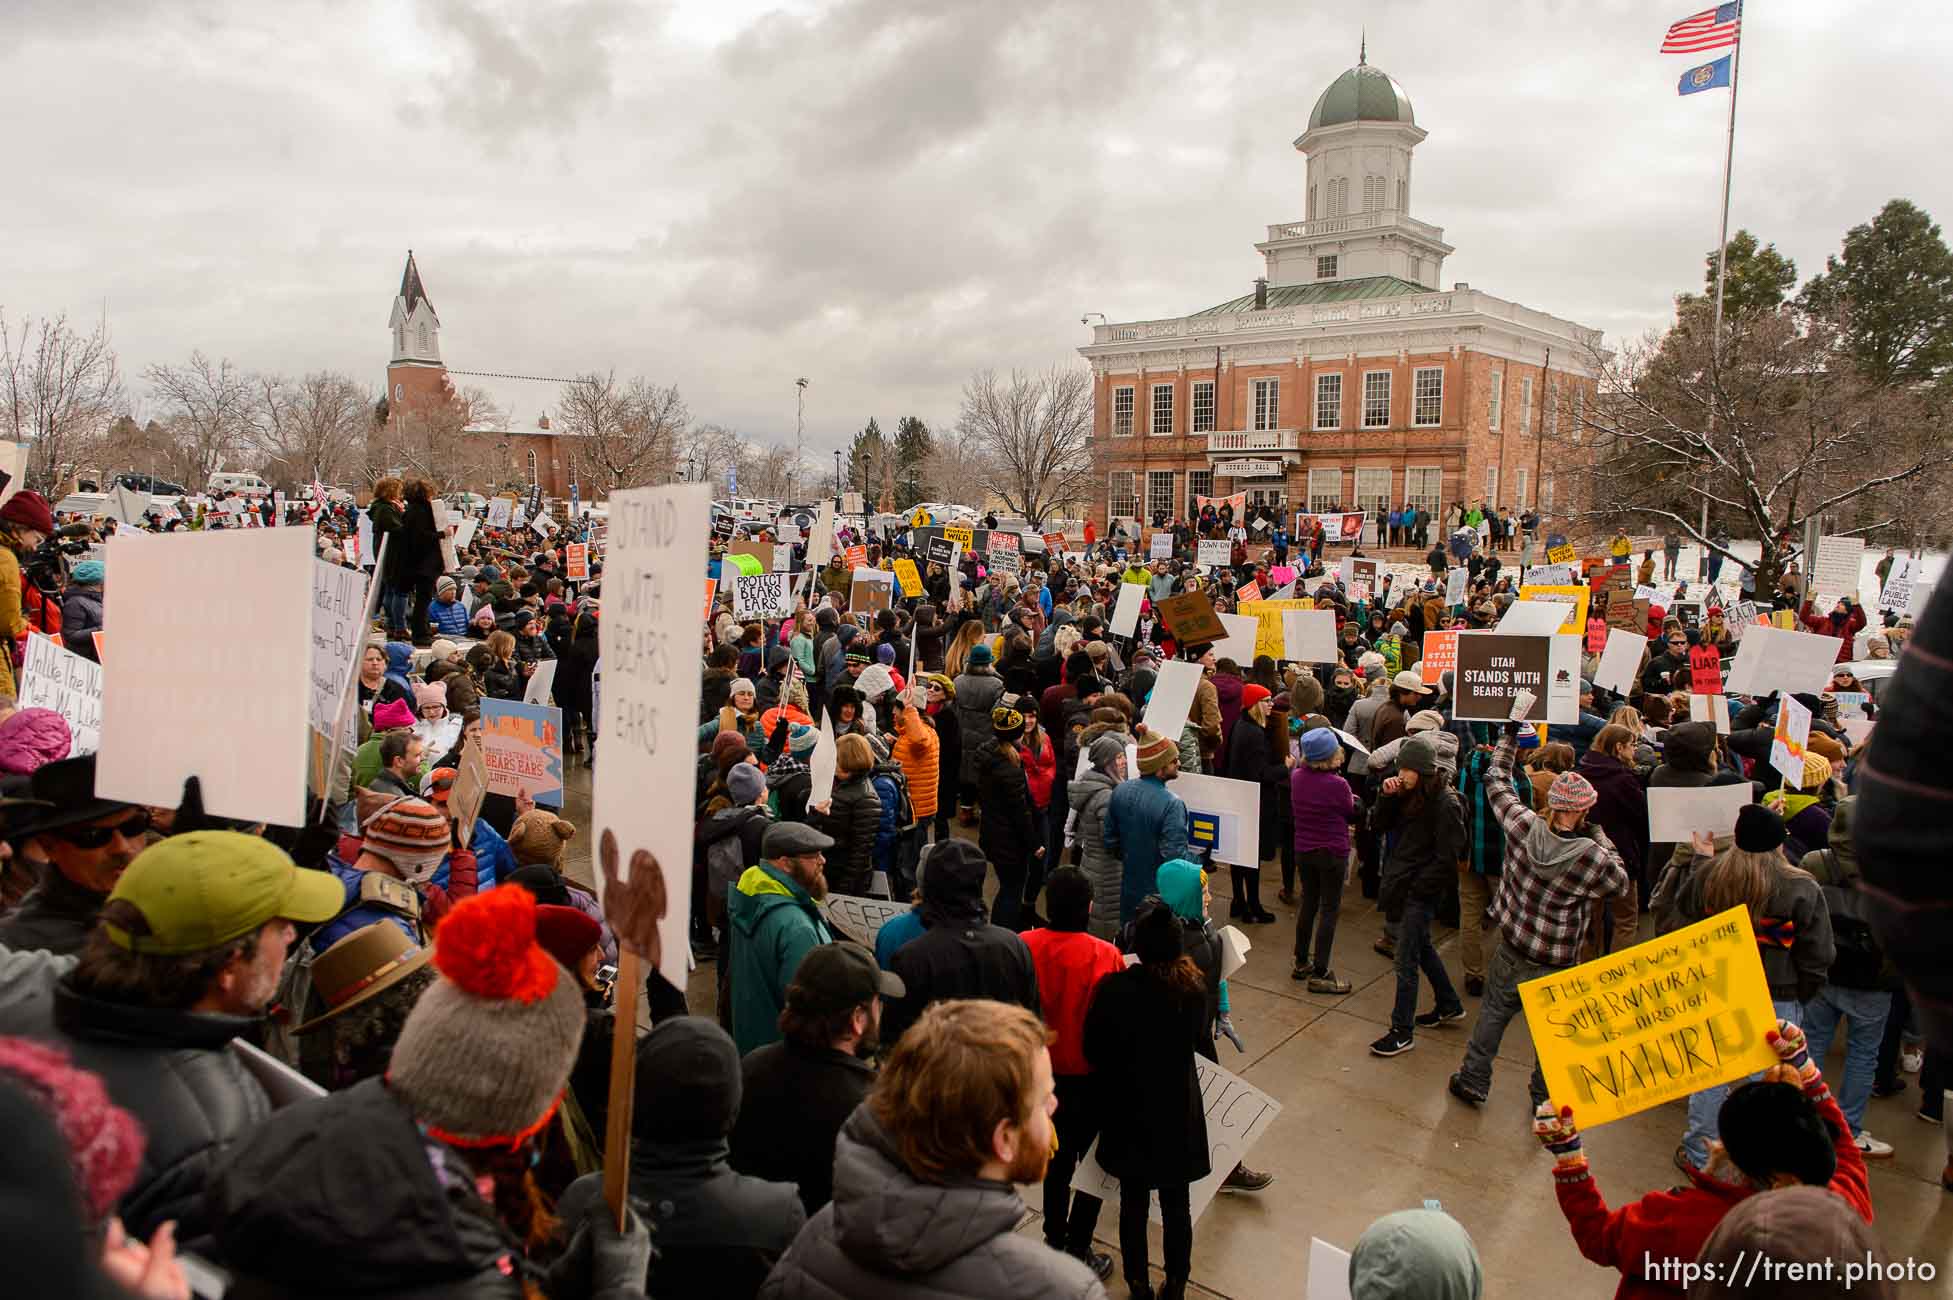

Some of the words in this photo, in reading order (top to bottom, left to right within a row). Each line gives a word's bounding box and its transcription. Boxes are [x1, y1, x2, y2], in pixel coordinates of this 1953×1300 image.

[617, 500, 678, 549] STAND
[947, 533, 969, 541] WILD
[737, 573, 784, 588] PROTECT
[620, 567, 666, 621] WITH
[740, 584, 782, 600] BEARS
[1884, 590, 1911, 600] PUBLIC
[744, 597, 778, 612] EARS
[1881, 598, 1907, 608] LANDS
[614, 623, 670, 686] BEARS
[1490, 657, 1516, 668] UTAH
[1692, 656, 1719, 671] LIAR
[1464, 670, 1509, 684] STANDS
[1513, 671, 1541, 685] WITH
[1472, 686, 1504, 697] BEARS
[615, 697, 660, 756] EARS
[485, 753, 516, 772] BEARS
[518, 759, 544, 777] EARS
[1541, 975, 1588, 1003] THE
[1599, 959, 1638, 984] ONLY
[1646, 944, 1679, 966] WAY
[1690, 934, 1709, 948] TO
[1713, 921, 1739, 941] THE
[1547, 963, 1714, 1038] SUPERNATURAL
[1601, 1031, 1622, 1043] IS
[1635, 991, 1709, 1030] THROUGH
